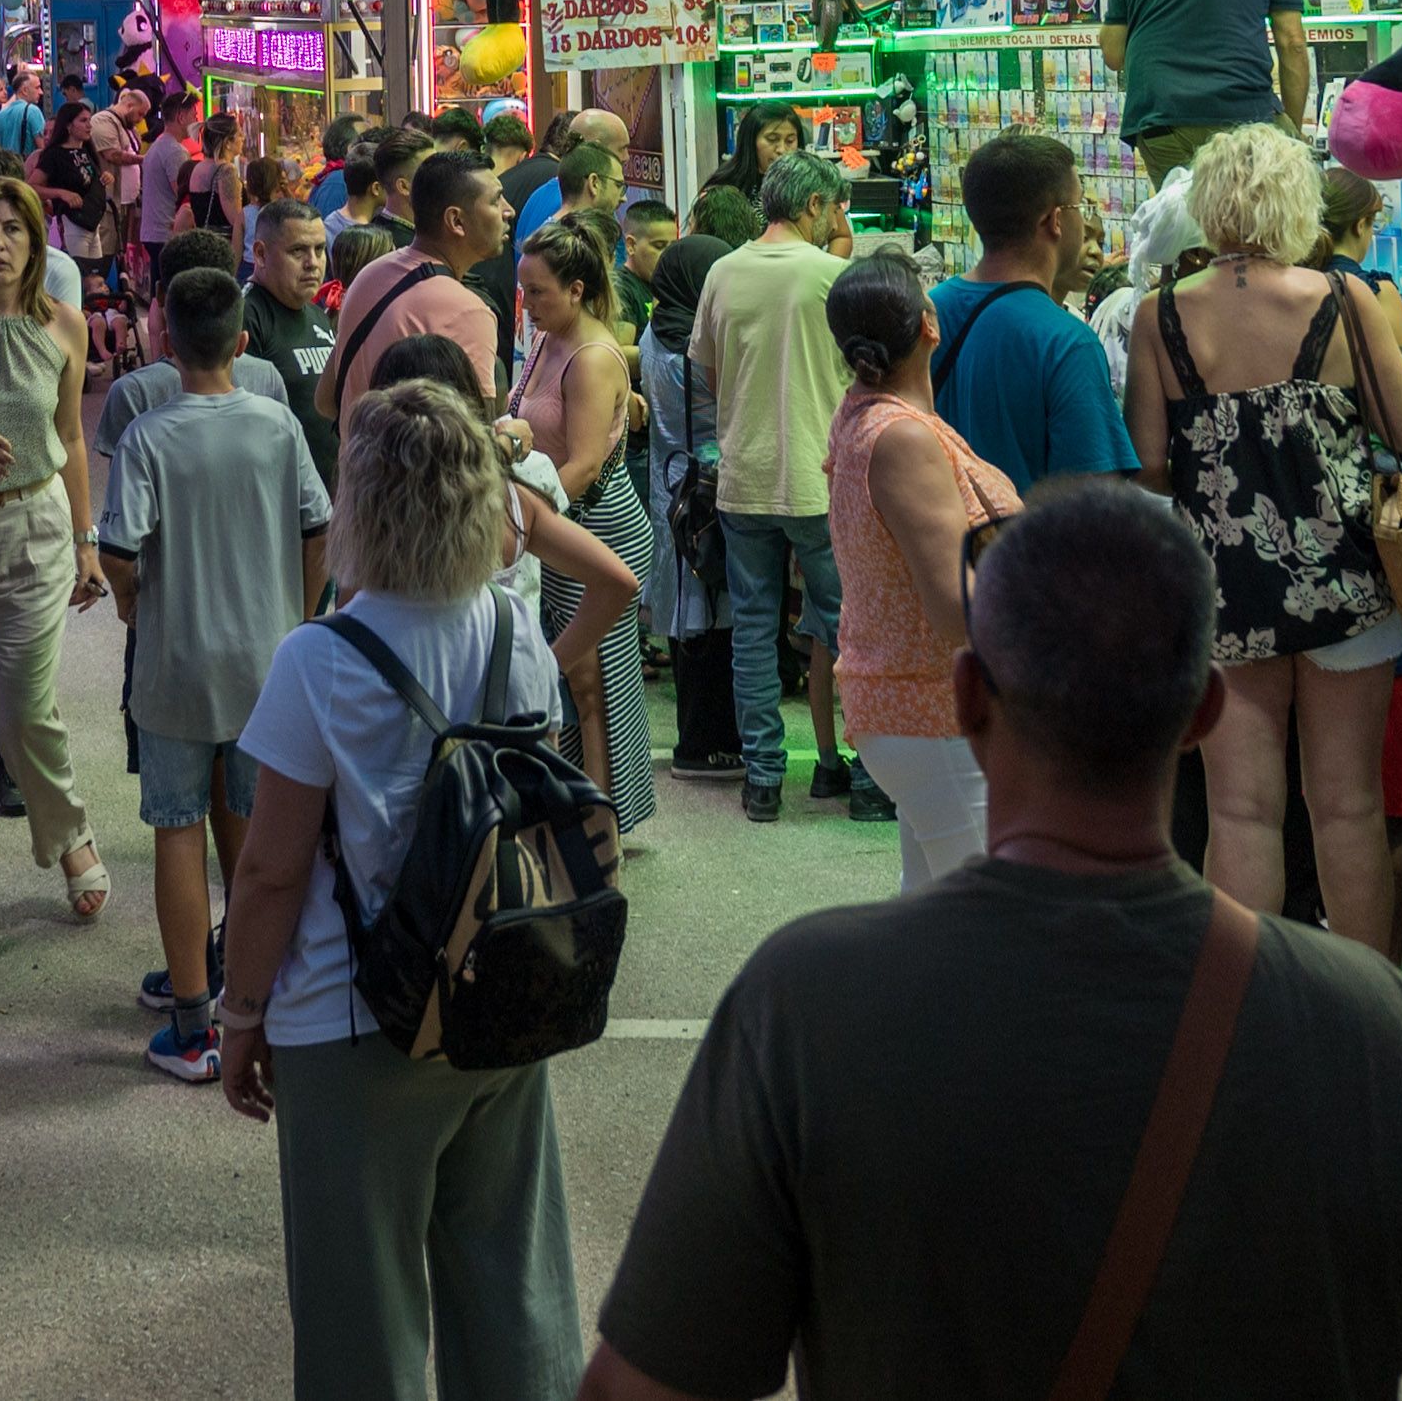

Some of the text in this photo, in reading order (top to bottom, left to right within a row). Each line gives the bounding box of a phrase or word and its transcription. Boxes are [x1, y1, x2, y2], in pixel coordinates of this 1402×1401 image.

[547, 2, 558, 20] 7
[550, 24, 711, 54] 15 DARDOS 10€
[960, 34, 1002, 46] SIEMPRE
[1005, 35, 1033, 45] TOCA
[1308, 28, 1354, 40] EMIOS
[293, 346, 334, 375] PUM
